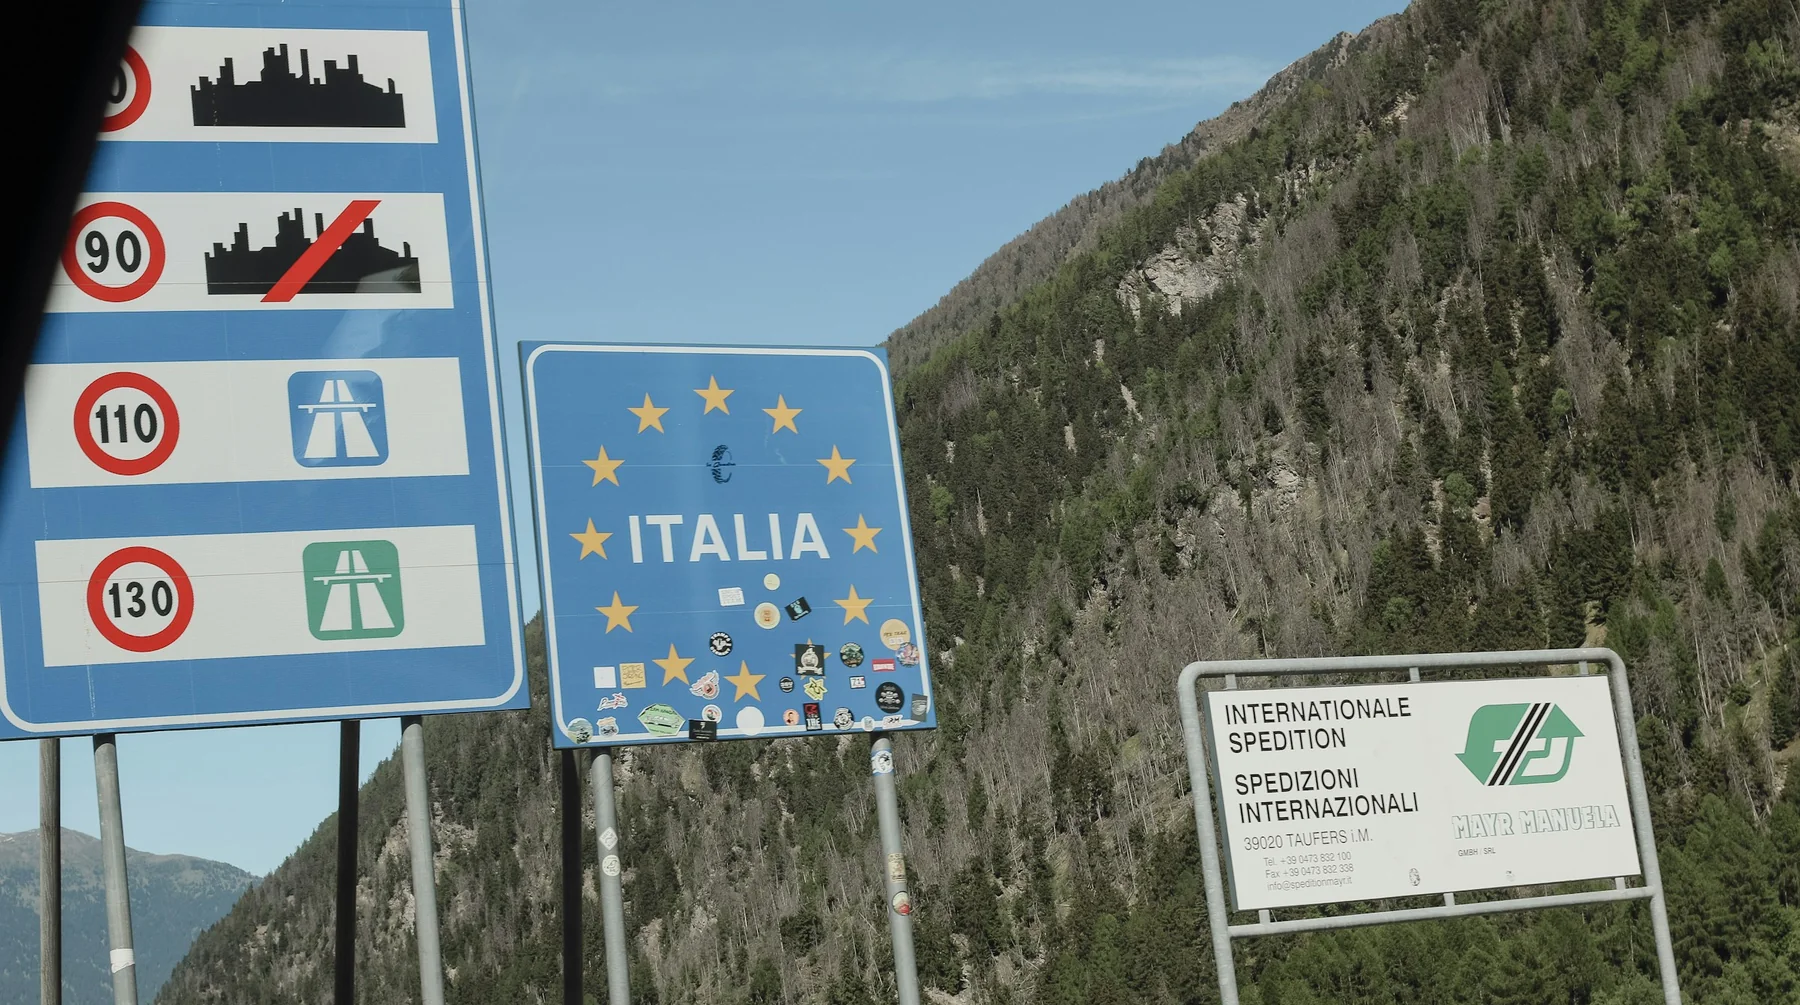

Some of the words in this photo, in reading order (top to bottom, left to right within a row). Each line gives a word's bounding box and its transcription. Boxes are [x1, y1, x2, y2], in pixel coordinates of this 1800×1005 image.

[107, 66, 127, 104] 0
[85, 230, 142, 273] 90
[95, 403, 158, 443] 110
[629, 512, 831, 564] ITALIA
[108, 580, 174, 618] 130
[1225, 697, 1411, 725] INTERNATIONALE
[1228, 727, 1347, 754] SPEDITION
[1234, 767, 1360, 796] SPEDIZIONI
[1239, 791, 1419, 824] INTERNAZIONALI
[1452, 812, 1514, 839] MAYR
[1519, 805, 1620, 834] MANUELA
[1243, 834, 1284, 851] 39020
[1286, 830, 1347, 847] TAUFERS
[1458, 848, 1478, 857] GMBH
[1483, 847, 1496, 855] SRL
[1265, 869, 1281, 879] Fax
[1282, 867, 1300, 878] +39
[1301, 866, 1321, 876] 0473
[1323, 864, 1338, 874] 832
[1280, 855, 1297, 865] +39
[1299, 853, 1319, 864] 0473
[1320, 852, 1336, 863] 832
[1337, 851, 1352, 861] 100
